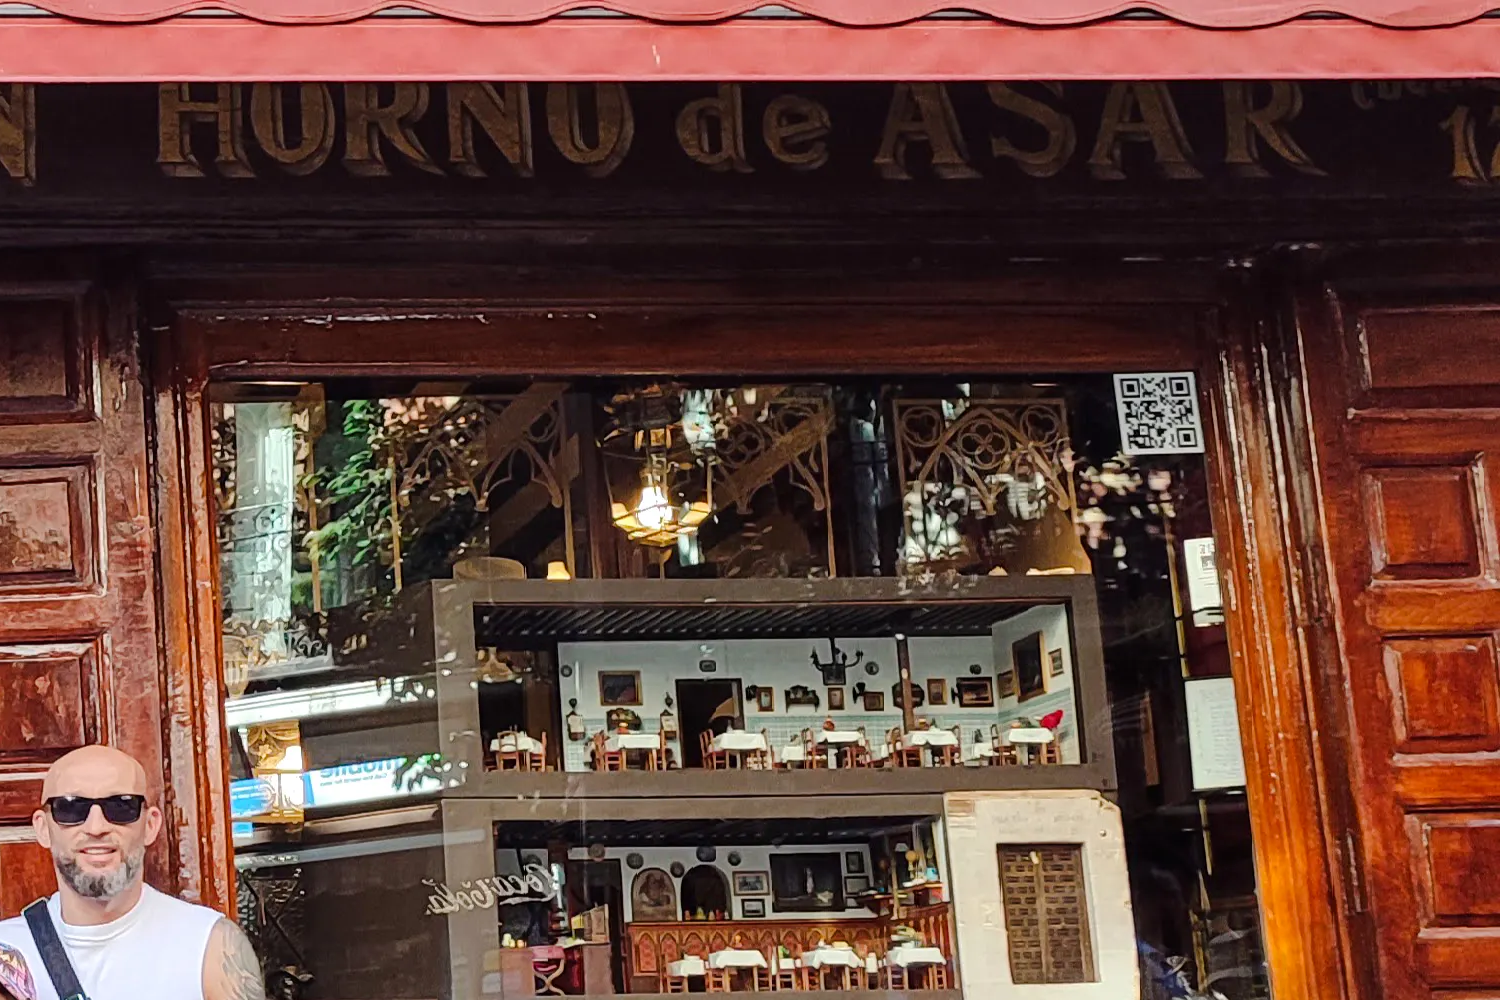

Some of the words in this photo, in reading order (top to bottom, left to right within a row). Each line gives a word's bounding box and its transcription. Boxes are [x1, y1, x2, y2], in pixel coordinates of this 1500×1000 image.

[156, 82, 634, 178] HORNO
[675, 84, 831, 173] de
[874, 82, 1329, 180] ASAR
